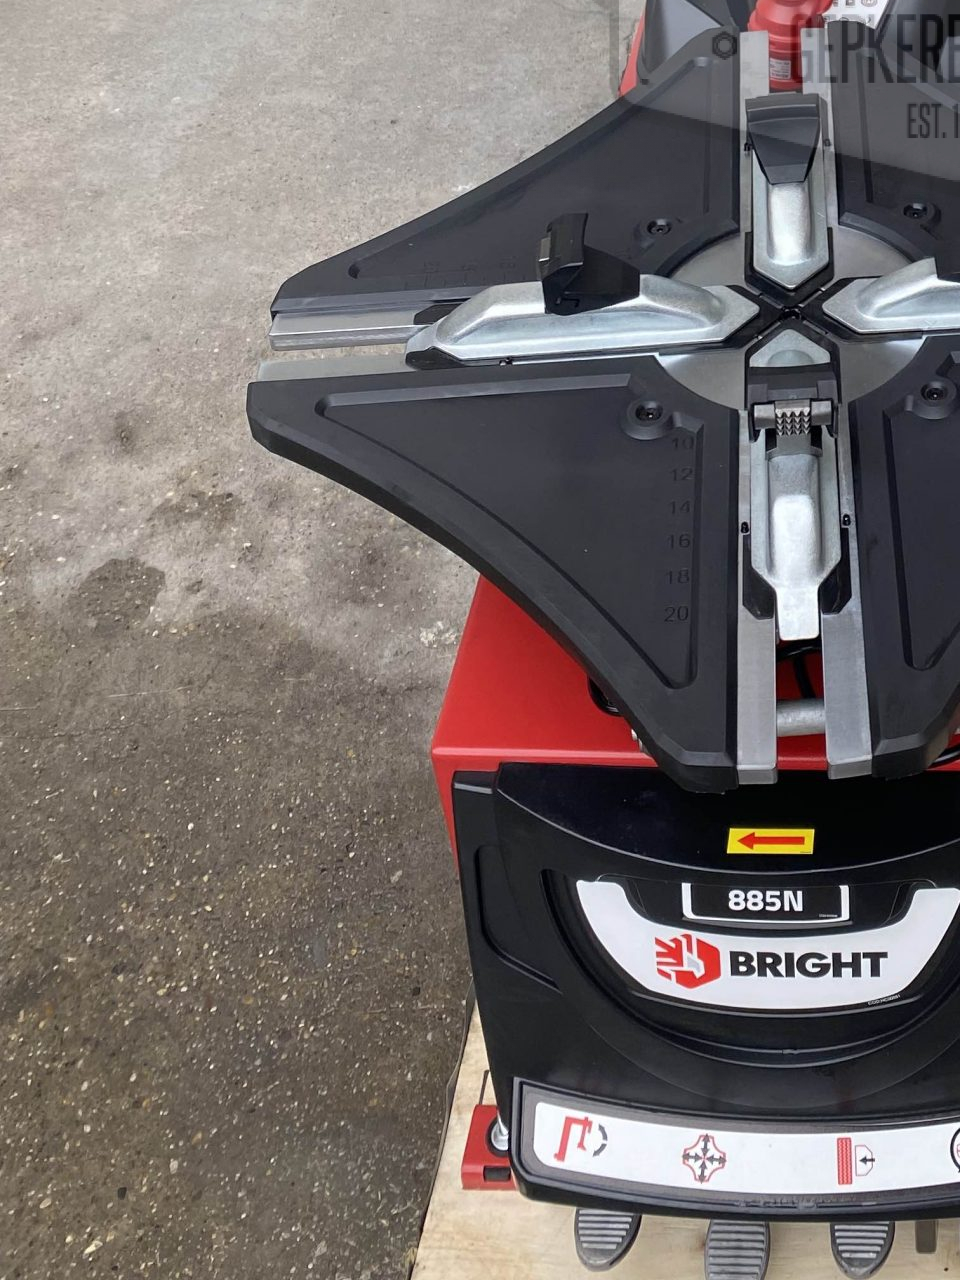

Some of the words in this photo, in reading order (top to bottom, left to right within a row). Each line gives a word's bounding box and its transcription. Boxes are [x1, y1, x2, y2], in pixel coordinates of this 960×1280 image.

[671, 435, 695, 450] 10
[671, 467, 693, 482] 12
[669, 500, 691, 516] 14
[667, 533, 691, 549] 16
[666, 569, 690, 585] 18
[663, 605, 689, 622] 20
[728, 889, 804, 912] 885N
[729, 950, 889, 979] BRIGHT
